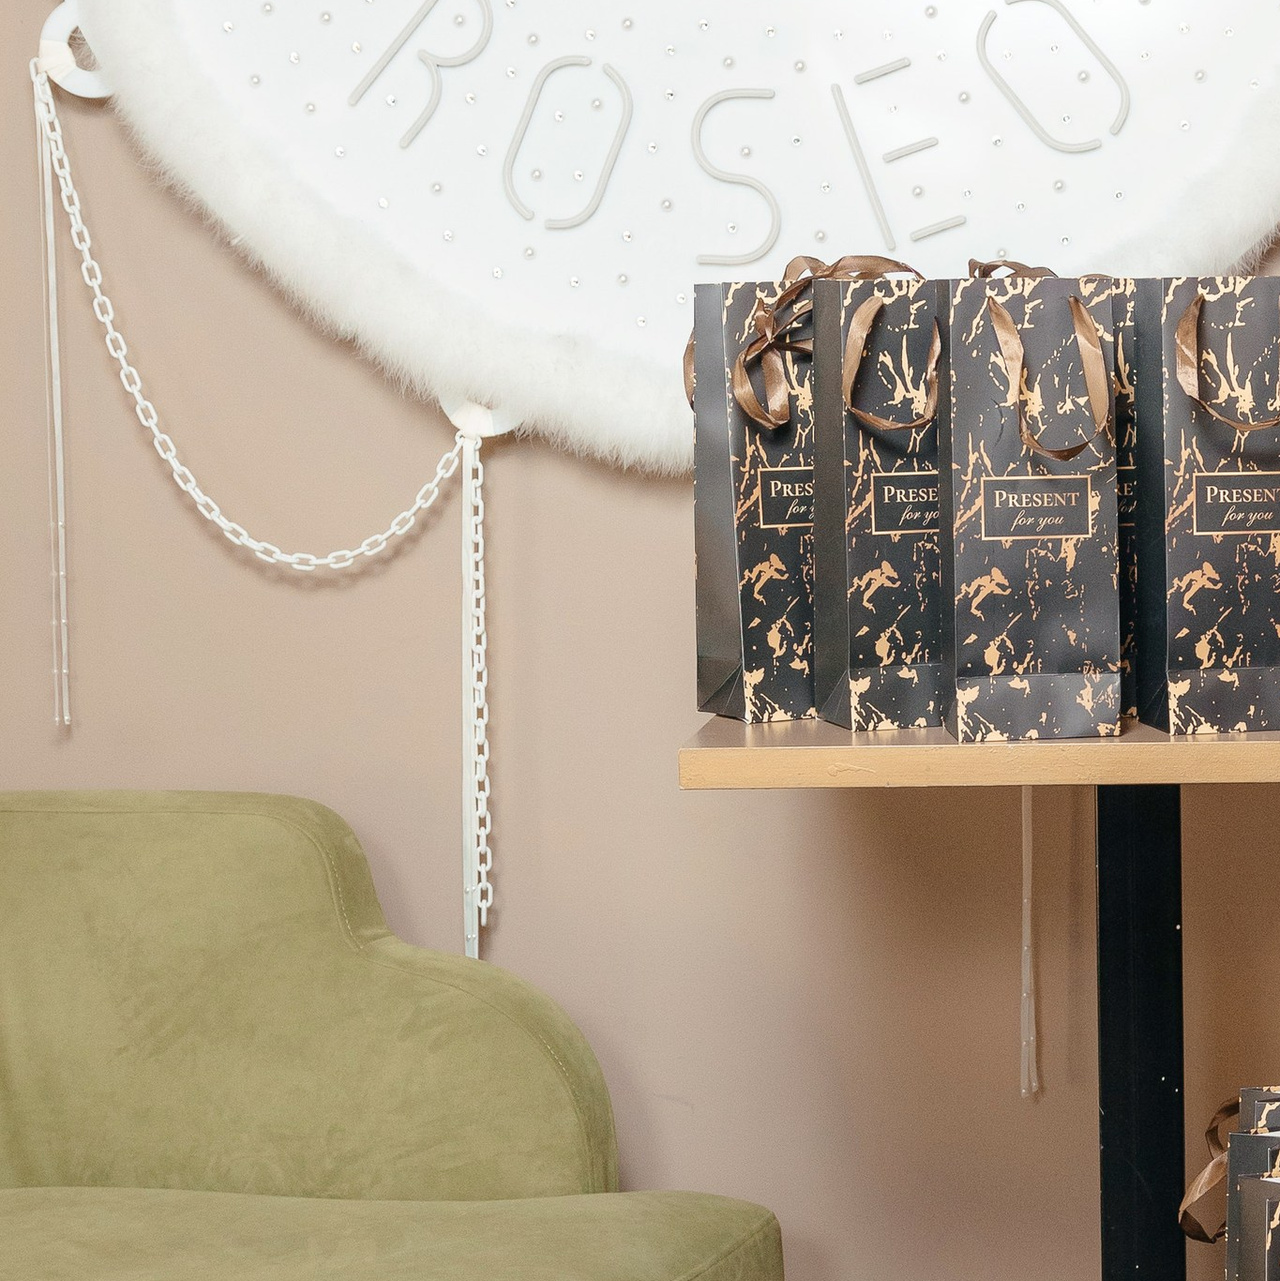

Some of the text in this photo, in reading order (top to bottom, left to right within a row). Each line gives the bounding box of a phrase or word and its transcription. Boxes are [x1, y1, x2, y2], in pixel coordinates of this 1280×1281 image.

[994, 489, 1080, 508] PRESENT
[899, 504, 922, 526] for
[1011, 510, 1065, 532] for you
[1221, 505, 1274, 527] for you
